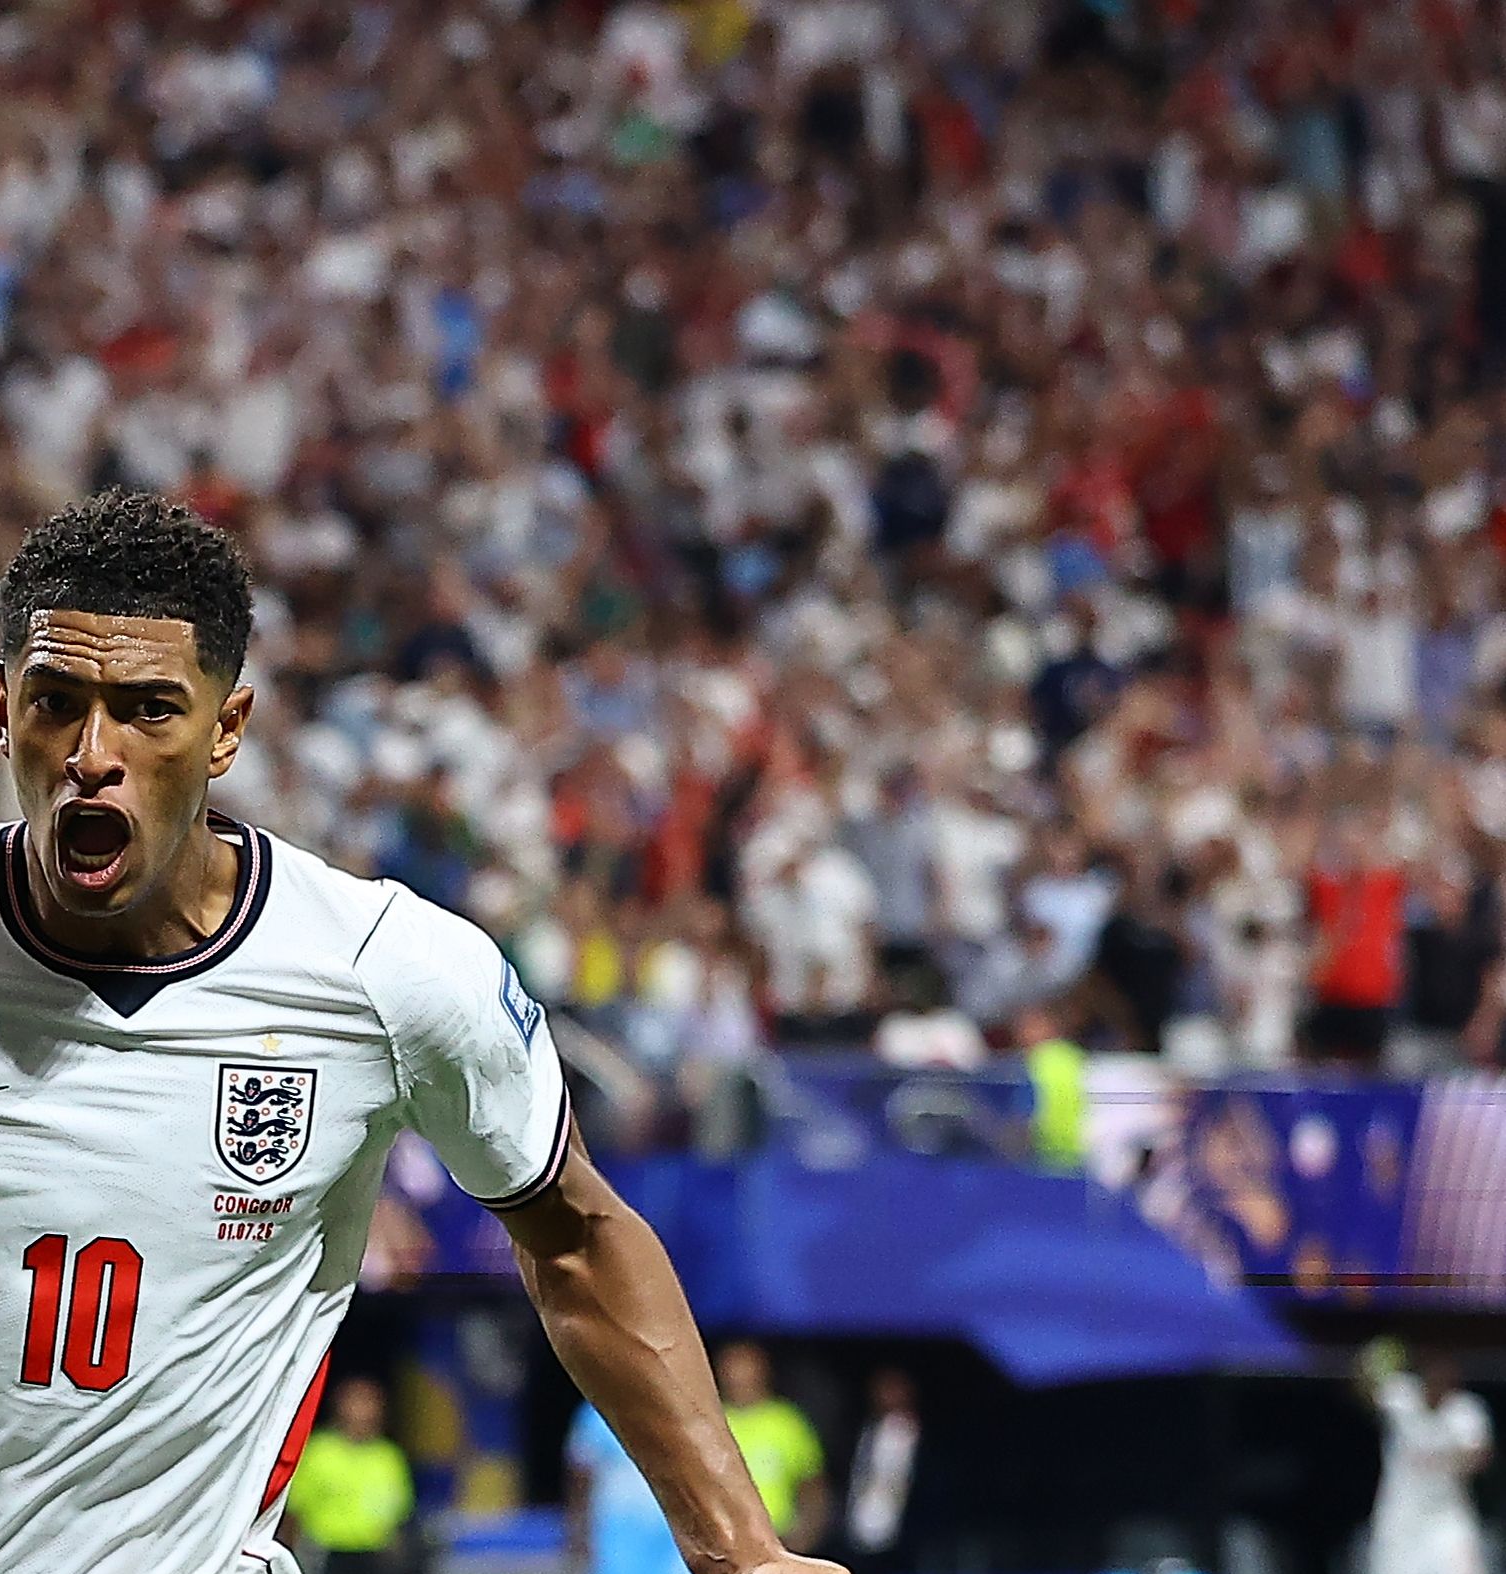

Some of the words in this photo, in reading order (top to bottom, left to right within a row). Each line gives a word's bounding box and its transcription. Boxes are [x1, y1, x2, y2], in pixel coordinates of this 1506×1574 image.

[214, 1194, 271, 1214] CONGO
[217, 1222, 274, 1240] 01.07.26
[20, 1233, 144, 1392] 10
